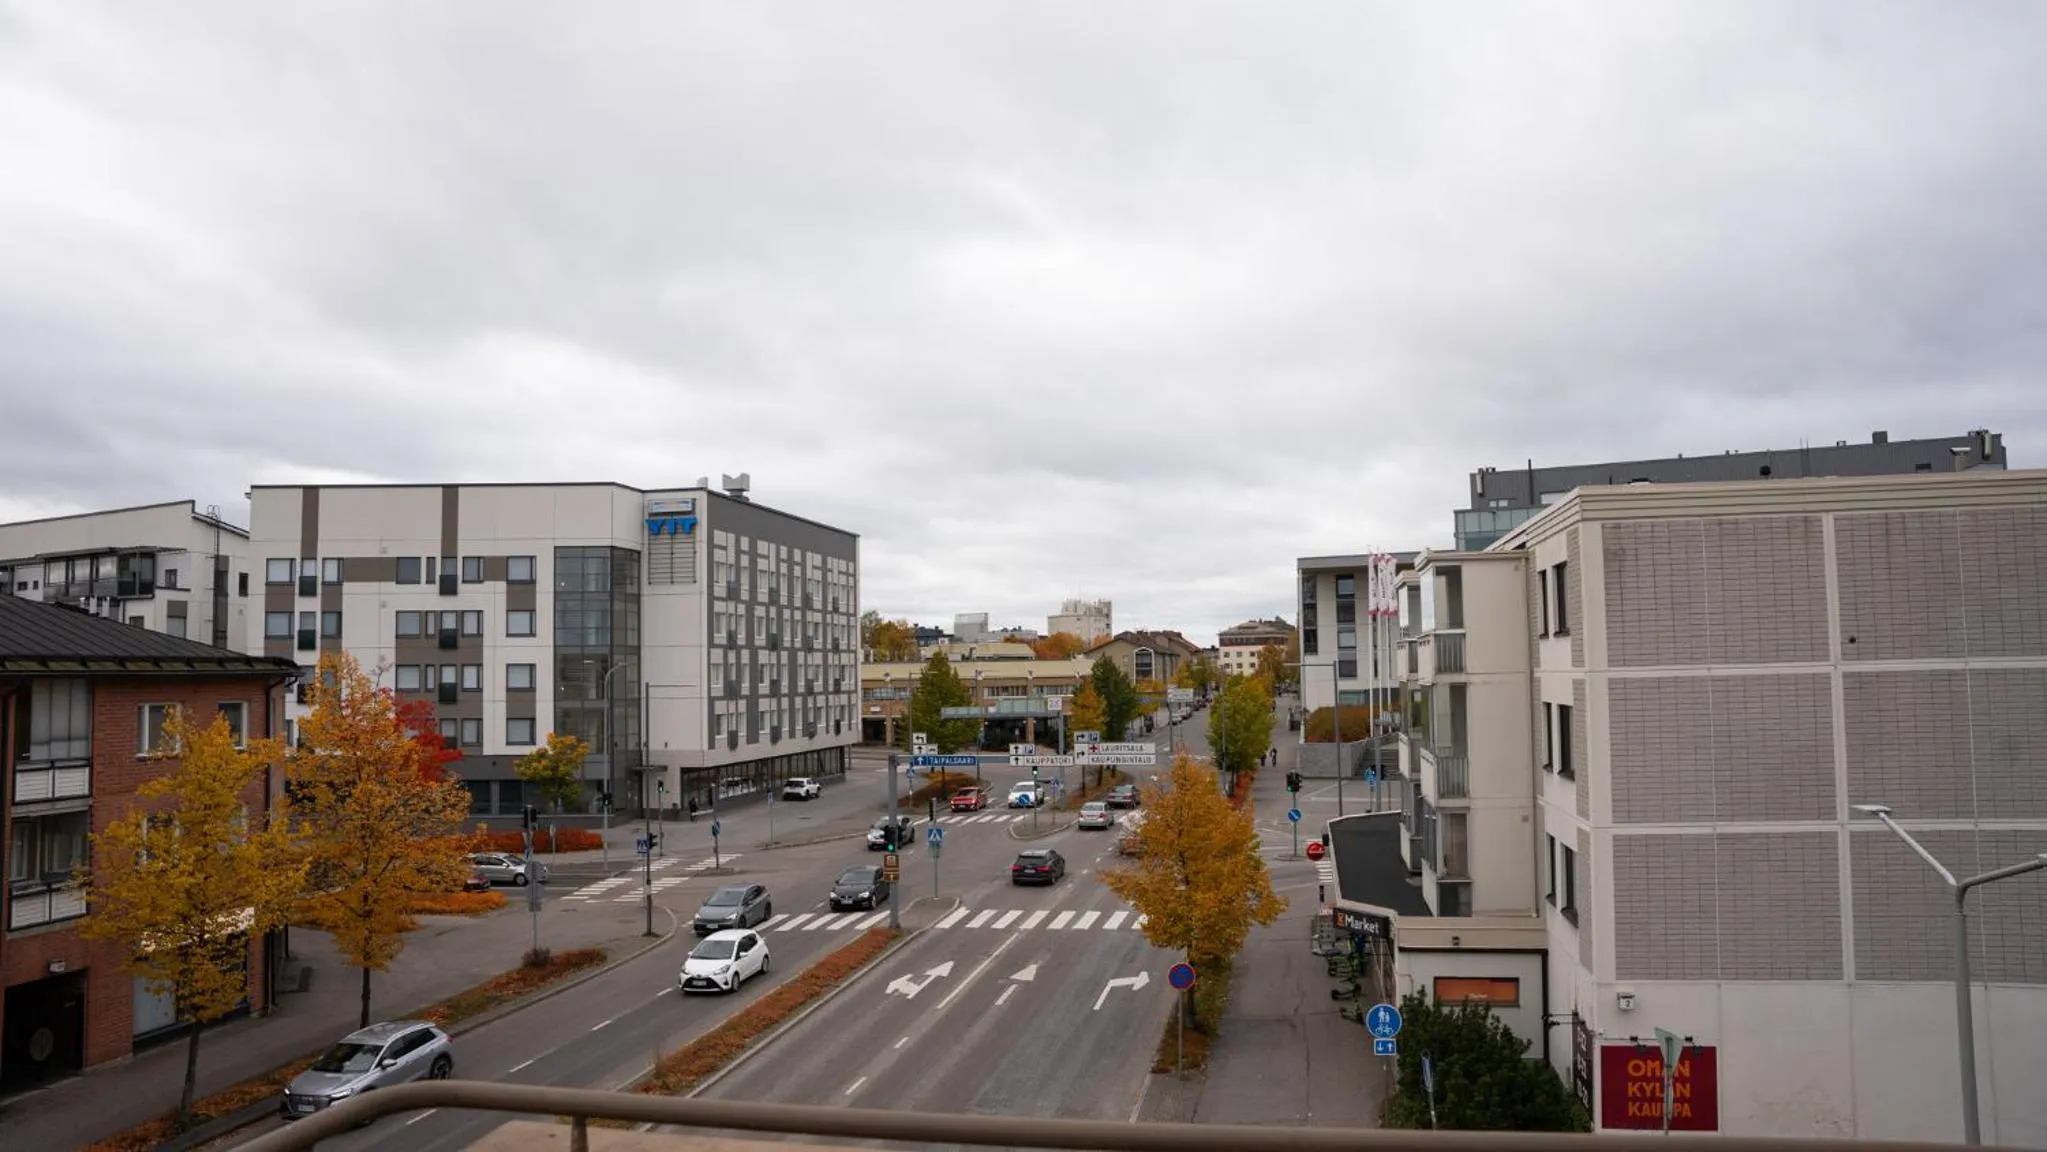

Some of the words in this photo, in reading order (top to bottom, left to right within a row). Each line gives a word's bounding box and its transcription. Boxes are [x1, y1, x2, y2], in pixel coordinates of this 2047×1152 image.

[645, 517, 697, 536] YIT
[1101, 743, 1144, 753] LAURITSALA
[929, 756, 975, 765] TAIPALSAARI
[1025, 757, 1071, 765] KAUPPATORI
[1345, 913, 1379, 934] Market
[1627, 1060, 1691, 1077] OMN
[1628, 1082, 1691, 1097] KYLN
[1628, 1102, 1692, 1117] KAUPA
